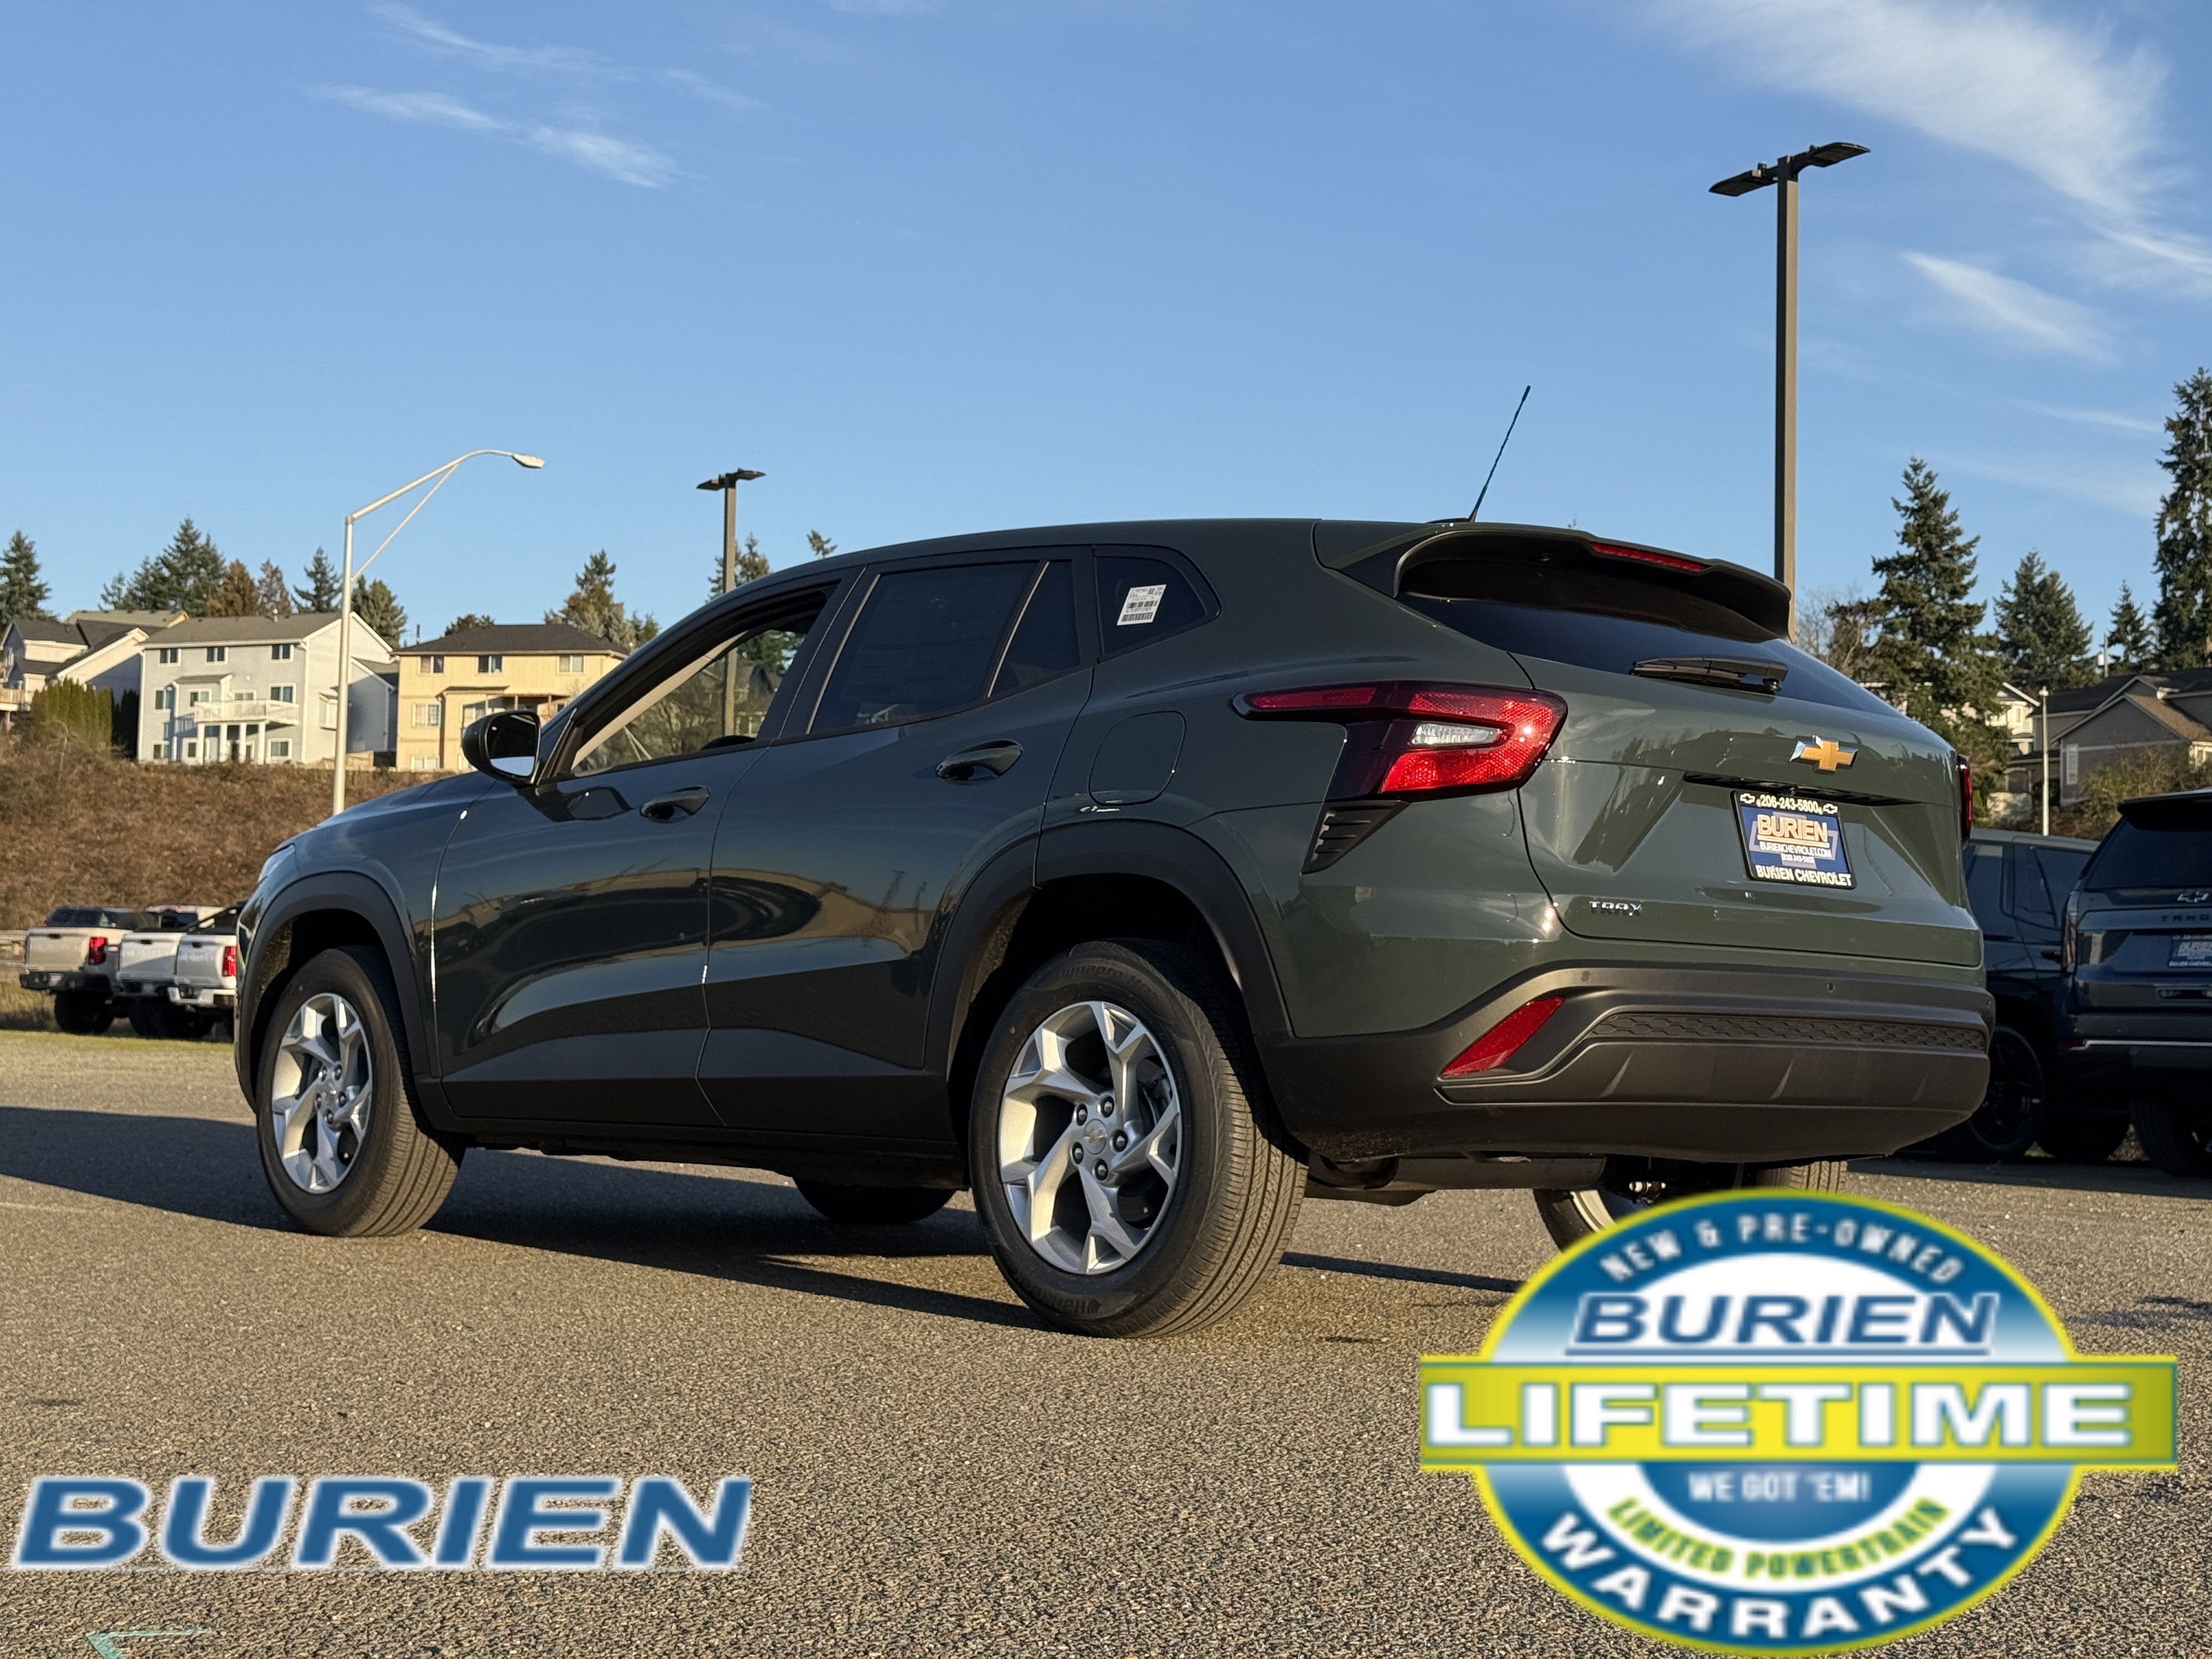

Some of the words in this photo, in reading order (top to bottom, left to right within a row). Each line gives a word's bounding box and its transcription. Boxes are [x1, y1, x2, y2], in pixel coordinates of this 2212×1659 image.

[1759, 794, 1820, 814] 206-243-5800
[1757, 814, 1827, 843] BURIEN
[1756, 865, 1792, 881] BURIEN
[1795, 872, 1852, 887] CHEVROLET
